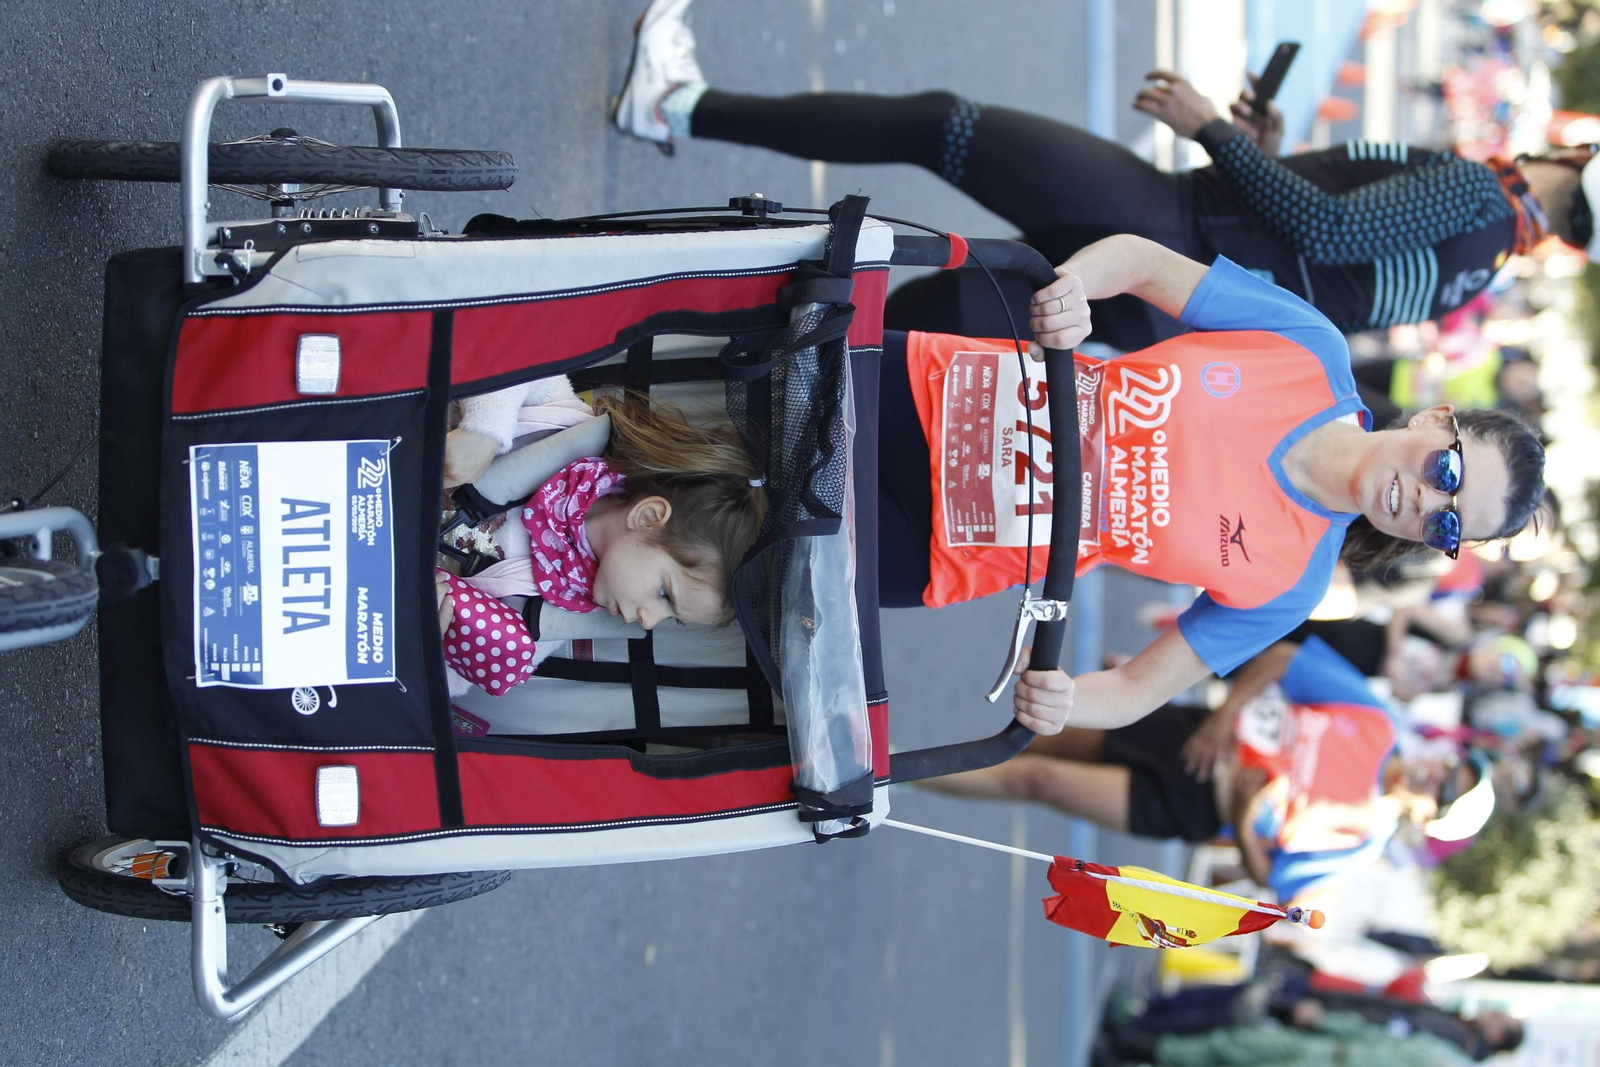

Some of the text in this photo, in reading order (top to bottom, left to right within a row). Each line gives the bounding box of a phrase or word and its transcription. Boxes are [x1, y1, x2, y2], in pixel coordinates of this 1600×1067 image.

[982, 366, 994, 388] NEXA
[982, 393, 991, 411] CDX
[1088, 400, 1096, 424] MEDIO
[982, 428, 990, 454] ALMERÍA
[1002, 427, 1014, 468] SARA
[202, 472, 210, 500] cajamar
[218, 461, 226, 491] Blanes
[239, 460, 250, 488] NEXA
[1150, 446, 1170, 527] MEDIO
[241, 495, 254, 518] CDX
[375, 494, 383, 527] MEDIO
[1082, 472, 1092, 528] CARRERA
[1109, 445, 1131, 548] ALMERÍA
[1130, 446, 1153, 564] MARATÓN
[358, 495, 367, 541] ALMERÍA
[367, 494, 376, 546] MARATÓN
[246, 540, 255, 574] ALMERÍA
[1220, 514, 1230, 567] MIZUNO
[281, 498, 331, 635] ATLETA
[357, 586, 370, 664] MARATÓN
[372, 612, 384, 663] MEDIO
